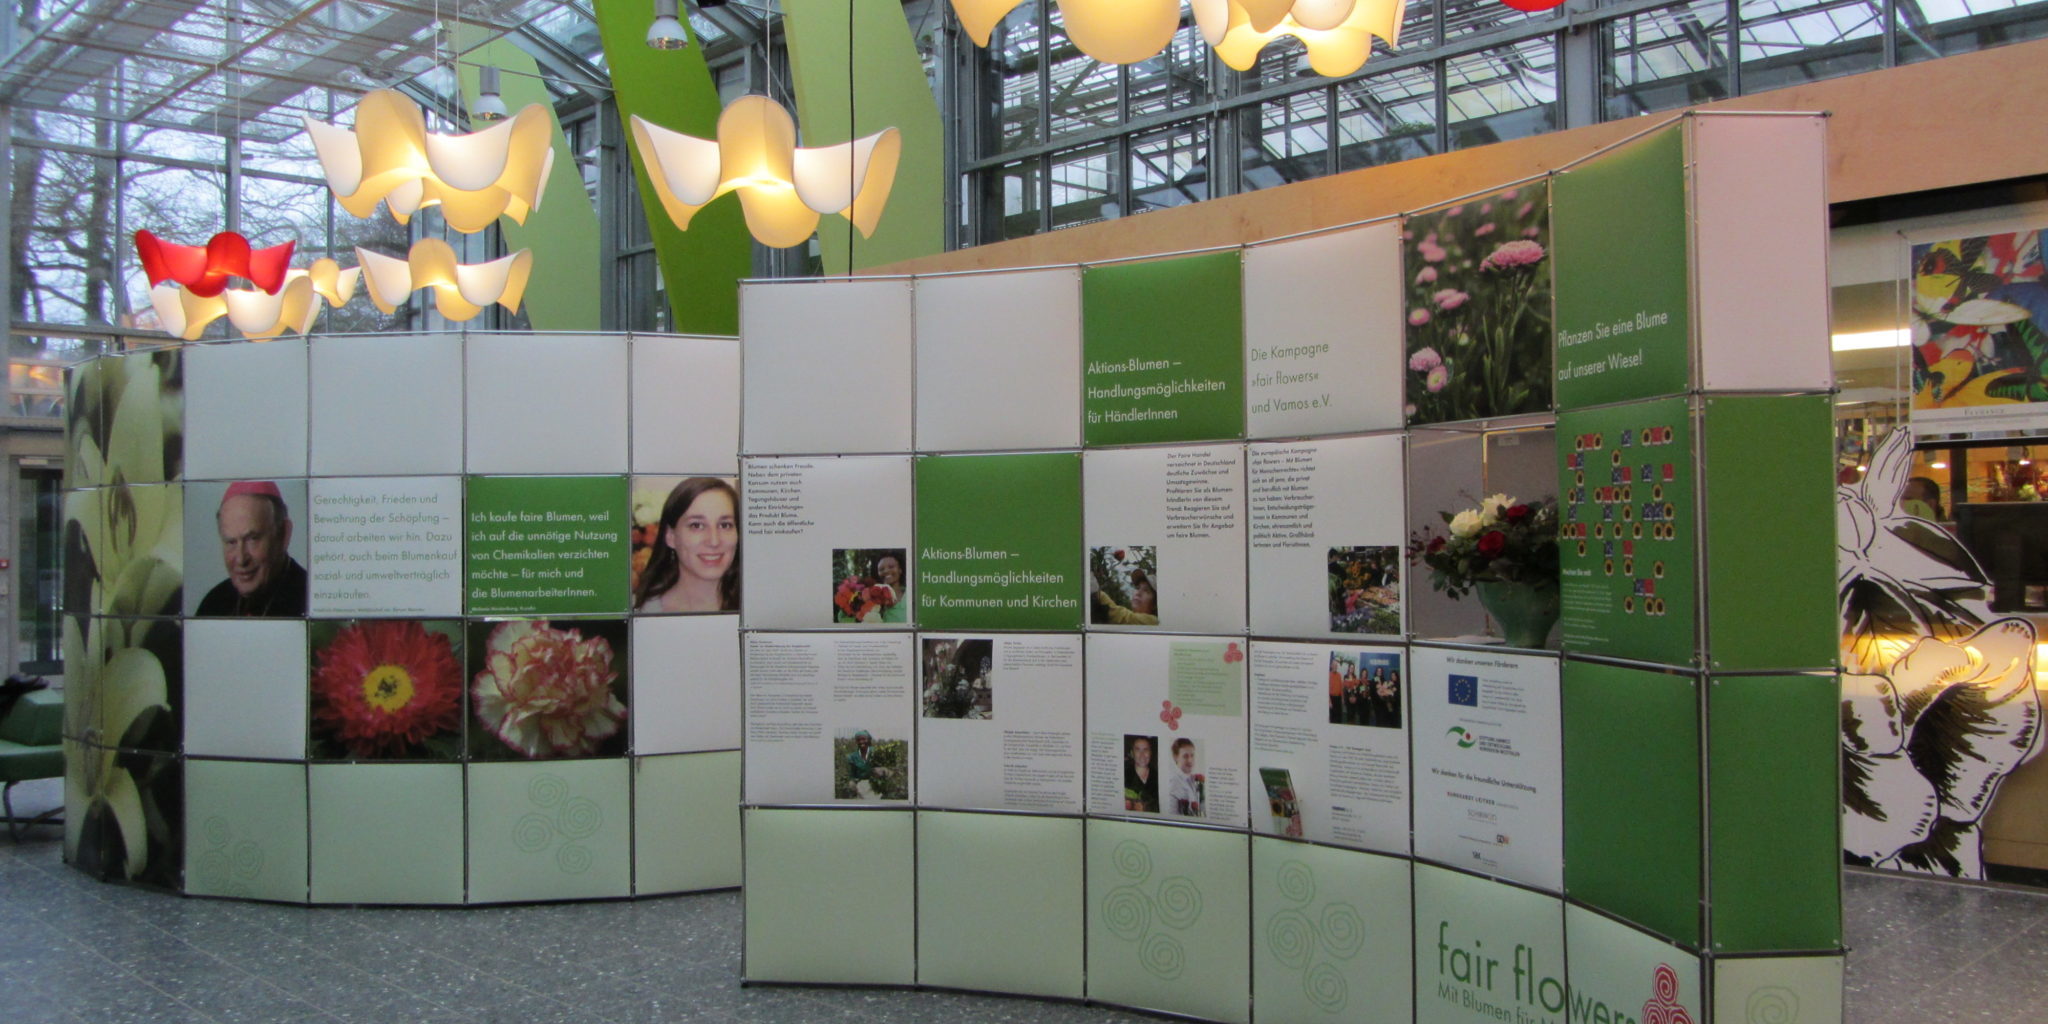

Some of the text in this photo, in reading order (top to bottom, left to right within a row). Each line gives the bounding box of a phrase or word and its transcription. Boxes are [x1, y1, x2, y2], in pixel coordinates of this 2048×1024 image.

[1558, 311, 1667, 348] Pflanzen Sie eine Blume
[1252, 343, 1329, 361] Die Kampagne
[1088, 358, 1169, 375] Aktions-Blumen
[1559, 348, 1642, 380] auf unserer Wiese!
[1252, 371, 1319, 387] »fair flowers«
[1088, 379, 1225, 399] Handlungsmöglichkeiten
[1252, 399, 1270, 414] und
[1273, 398, 1309, 411] Vamos
[1088, 408, 1178, 423] für HändlerInnen
[314, 493, 438, 506] Gerechtigkeit, Frieden und
[314, 512, 439, 525] Bewahrung der Schöpfung
[471, 511, 609, 523] Ich kaufe faire Blumen, weil
[314, 532, 344, 542] darauf
[347, 532, 385, 542] arbeiten
[389, 533, 402, 541] wir
[426, 531, 452, 541] Dazu
[471, 531, 618, 543] ich auf die unnötige Nutzung
[349, 552, 372, 561] auch
[375, 551, 398, 561] beim
[402, 550, 457, 560] Blumenkauf
[471, 549, 609, 560] von Chemikalien verzichten
[922, 547, 1007, 560] Aktions-Blumen
[346, 571, 362, 580] und
[366, 569, 449, 582] umweltverträglich
[472, 568, 583, 579] möchte für mich und
[922, 571, 1063, 587] Handlungsmöglichkeiten
[472, 587, 597, 598] die BlumenarbeiterInnen.
[922, 595, 1077, 608] für Kommunen und Kirchen
[1474, 774, 1500, 786] freundliche
[1438, 921, 1635, 1024] fair flower
[1438, 981, 1458, 999] Mit
[1462, 989, 1511, 1021] Blumen
